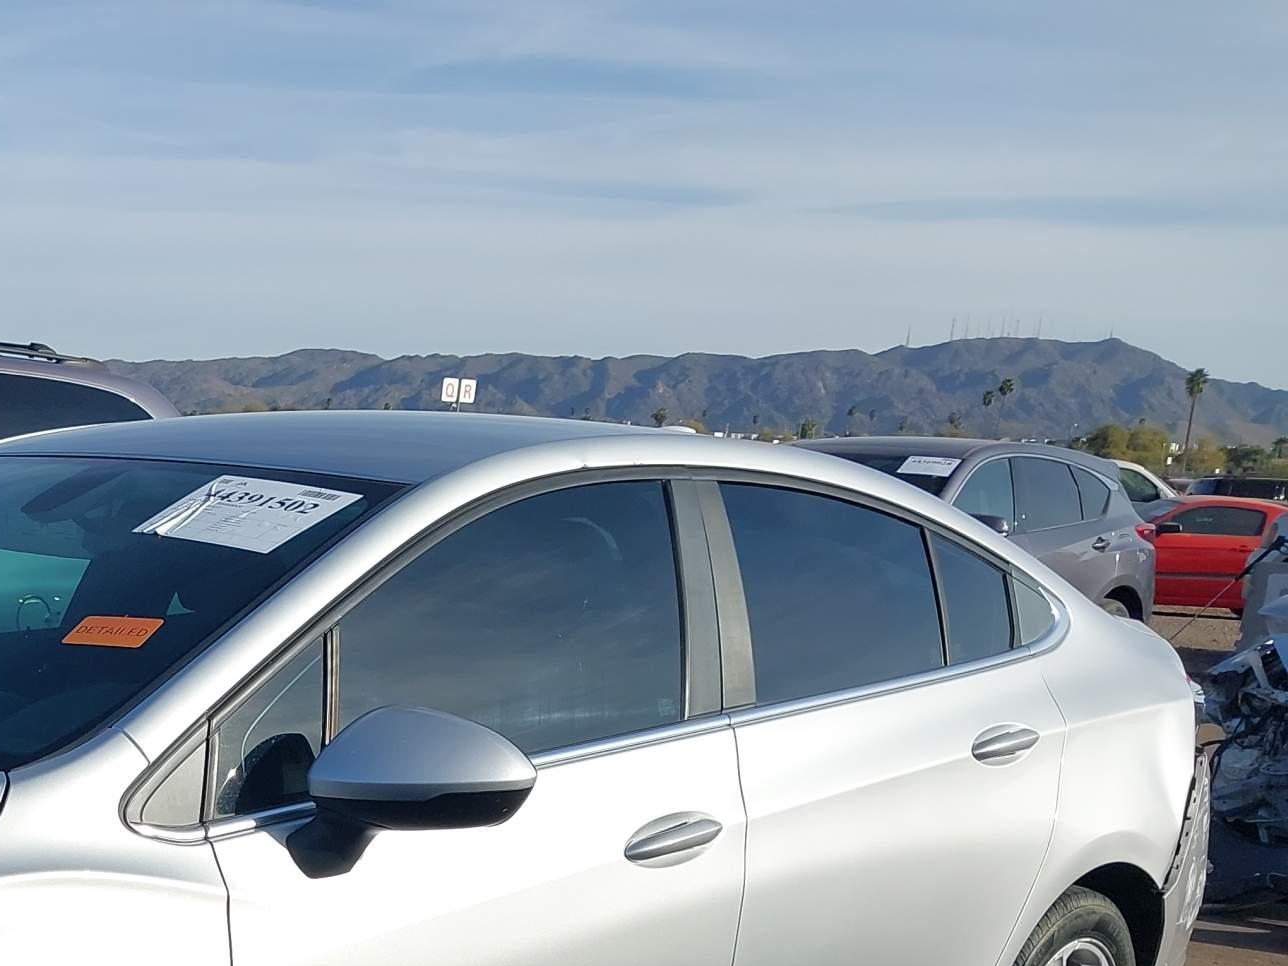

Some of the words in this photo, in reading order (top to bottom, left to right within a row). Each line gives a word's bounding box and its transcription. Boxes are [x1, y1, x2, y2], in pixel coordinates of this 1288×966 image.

[445, 382, 456, 399] Q
[463, 384, 472, 400] R
[75, 625, 149, 638] DETAILED
